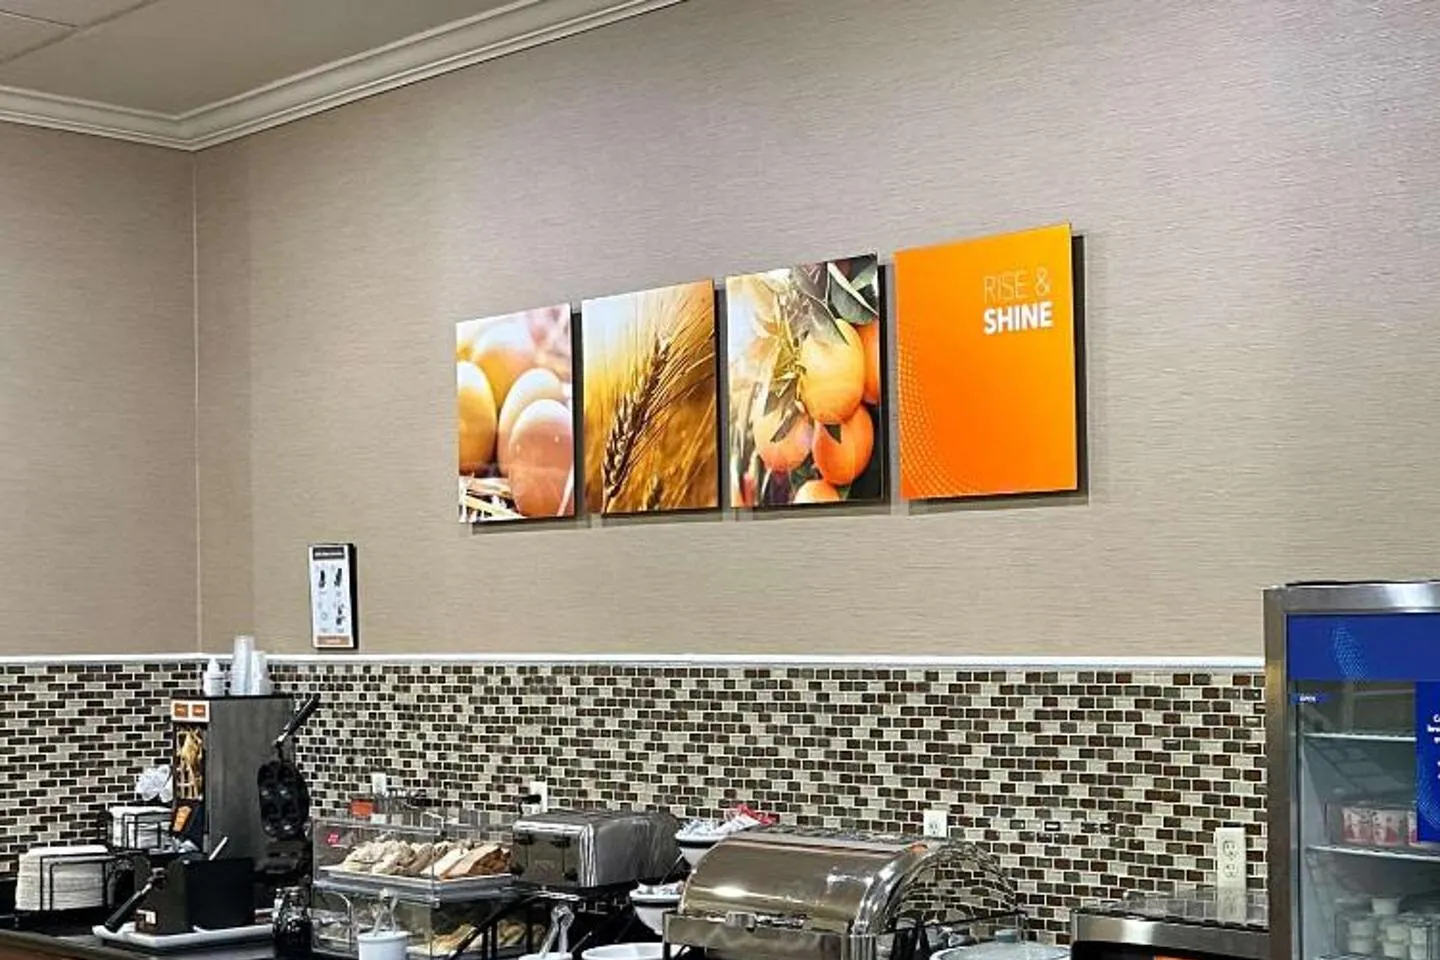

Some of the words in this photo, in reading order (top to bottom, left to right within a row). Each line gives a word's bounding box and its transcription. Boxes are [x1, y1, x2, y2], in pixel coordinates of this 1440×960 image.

[983, 270, 1028, 304] RISE
[1034, 266, 1051, 297] &
[984, 301, 1053, 334] SHINE
